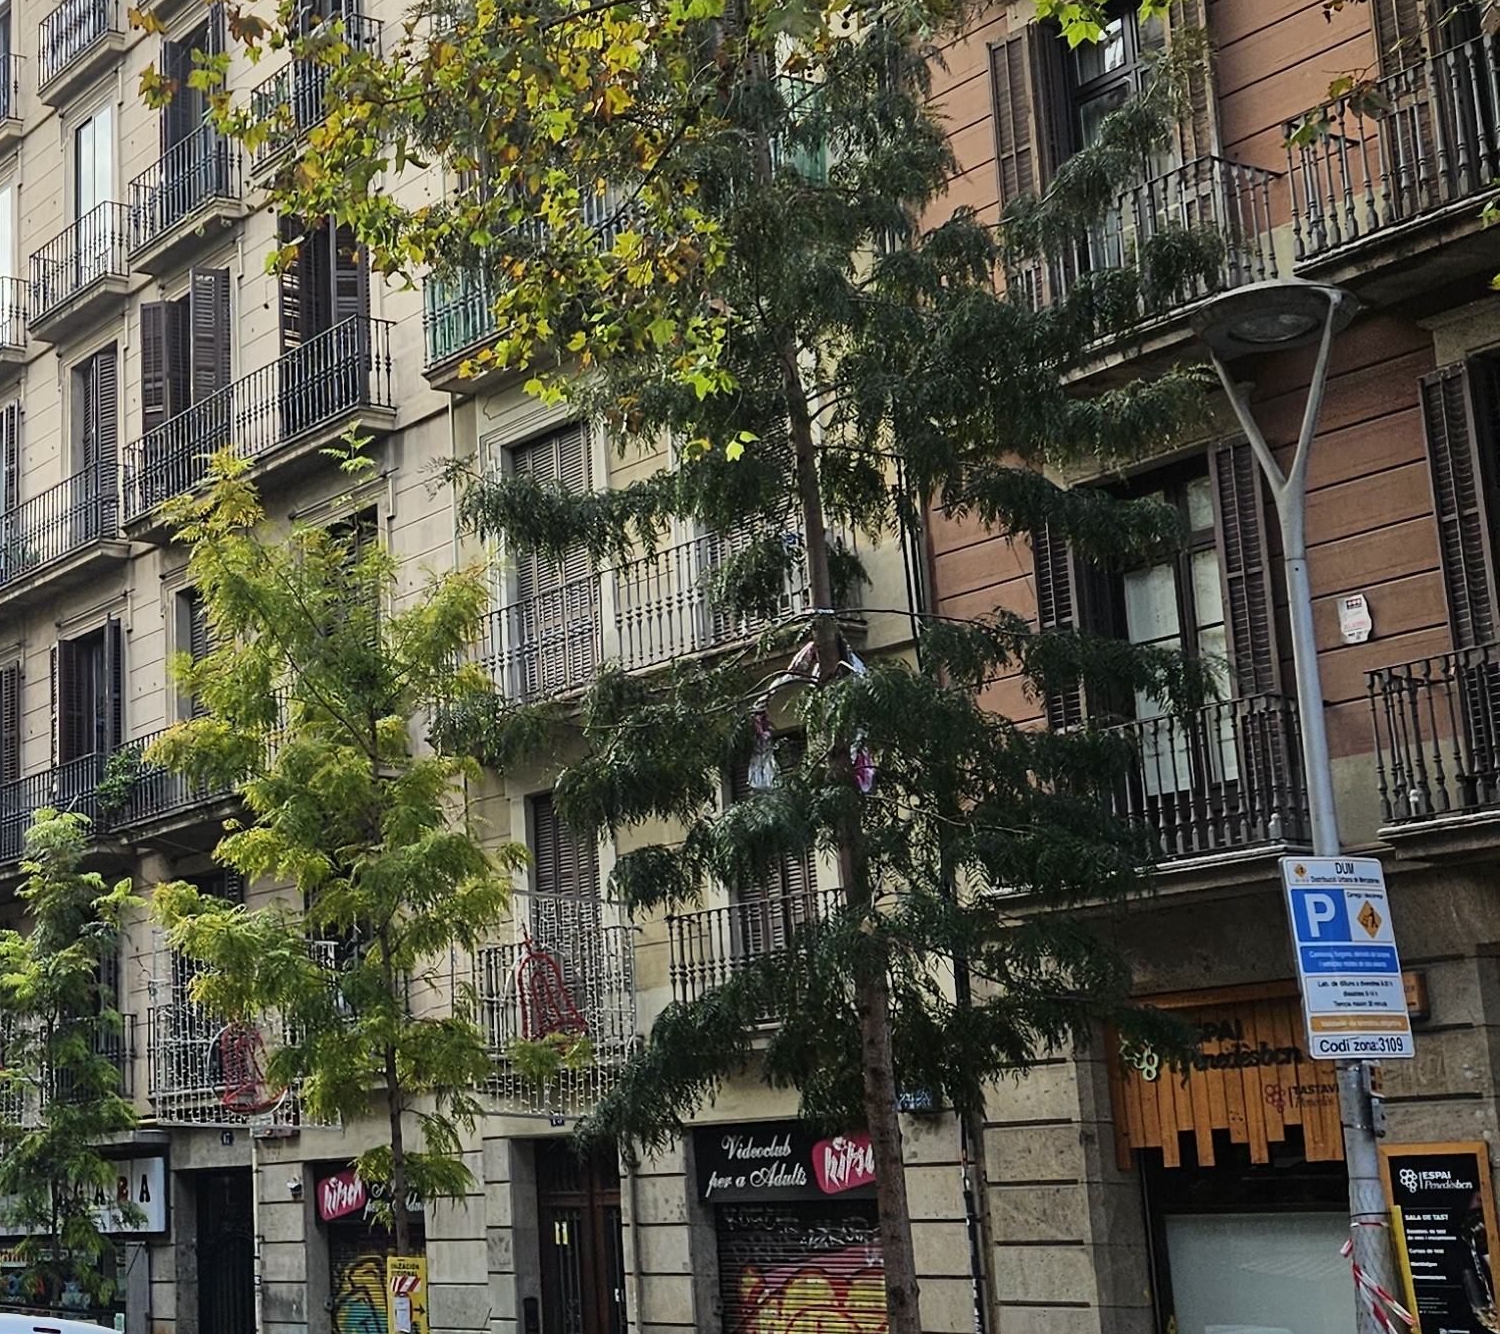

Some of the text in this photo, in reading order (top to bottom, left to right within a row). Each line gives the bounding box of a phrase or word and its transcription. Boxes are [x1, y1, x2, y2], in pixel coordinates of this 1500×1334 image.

[1334, 862, 1354, 874] DUM
[1304, 893, 1336, 938] P
[1320, 1039, 1350, 1053] Codi
[1292, 1083, 1339, 1095] TASTAVI
[721, 1133, 791, 1160] Videoclub
[705, 1161, 808, 1198] per a Adults
[1422, 1171, 1452, 1180] ESPAI
[1425, 1179, 1473, 1189] Penedèsbcn
